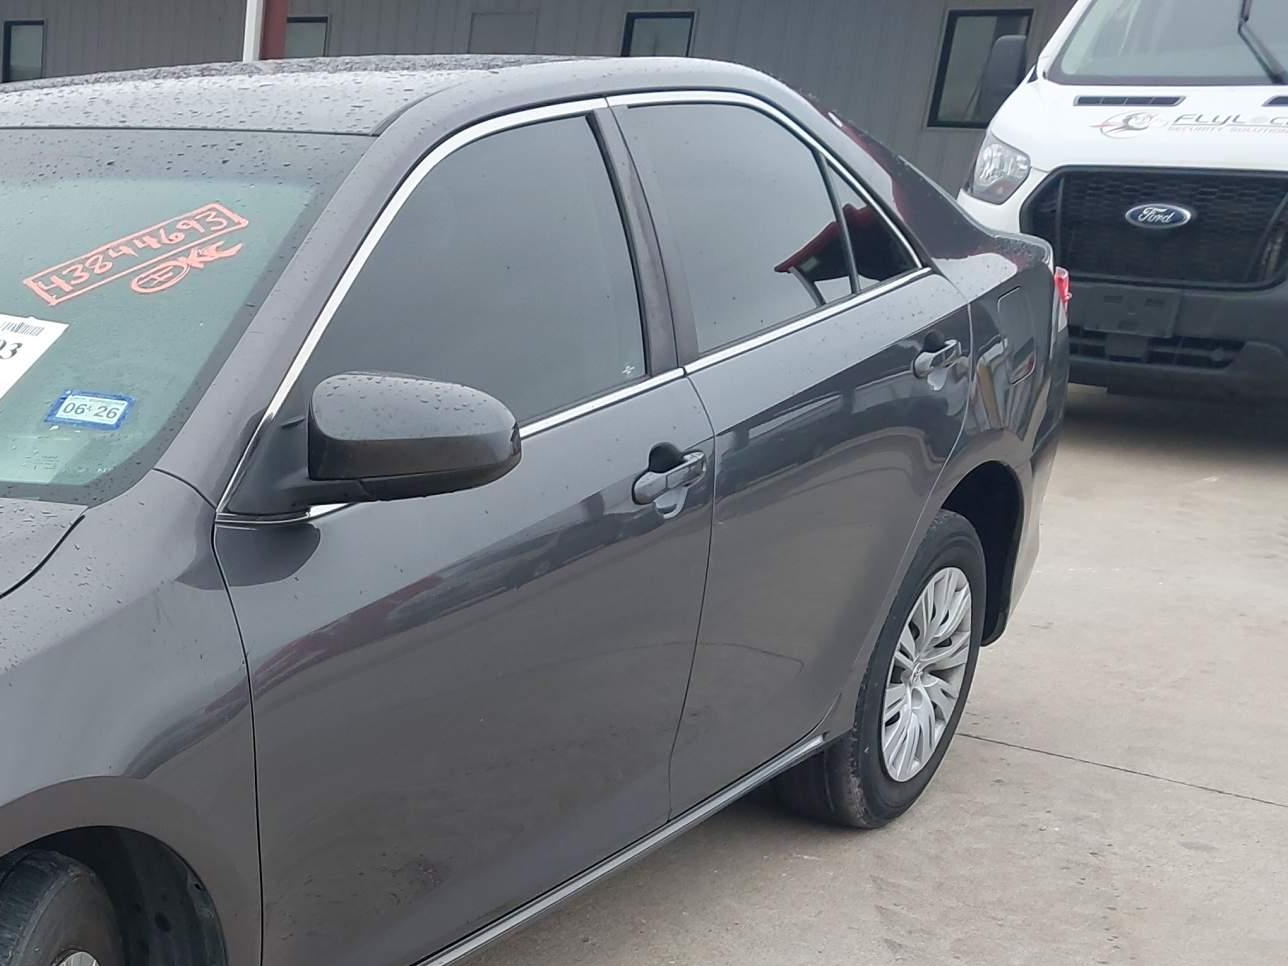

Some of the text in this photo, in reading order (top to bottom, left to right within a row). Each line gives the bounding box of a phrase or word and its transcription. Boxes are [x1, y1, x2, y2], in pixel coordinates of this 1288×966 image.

[1138, 207, 1175, 223] Ford
[37, 210, 228, 292] 43844693
[62, 402, 121, 419] 06 26
